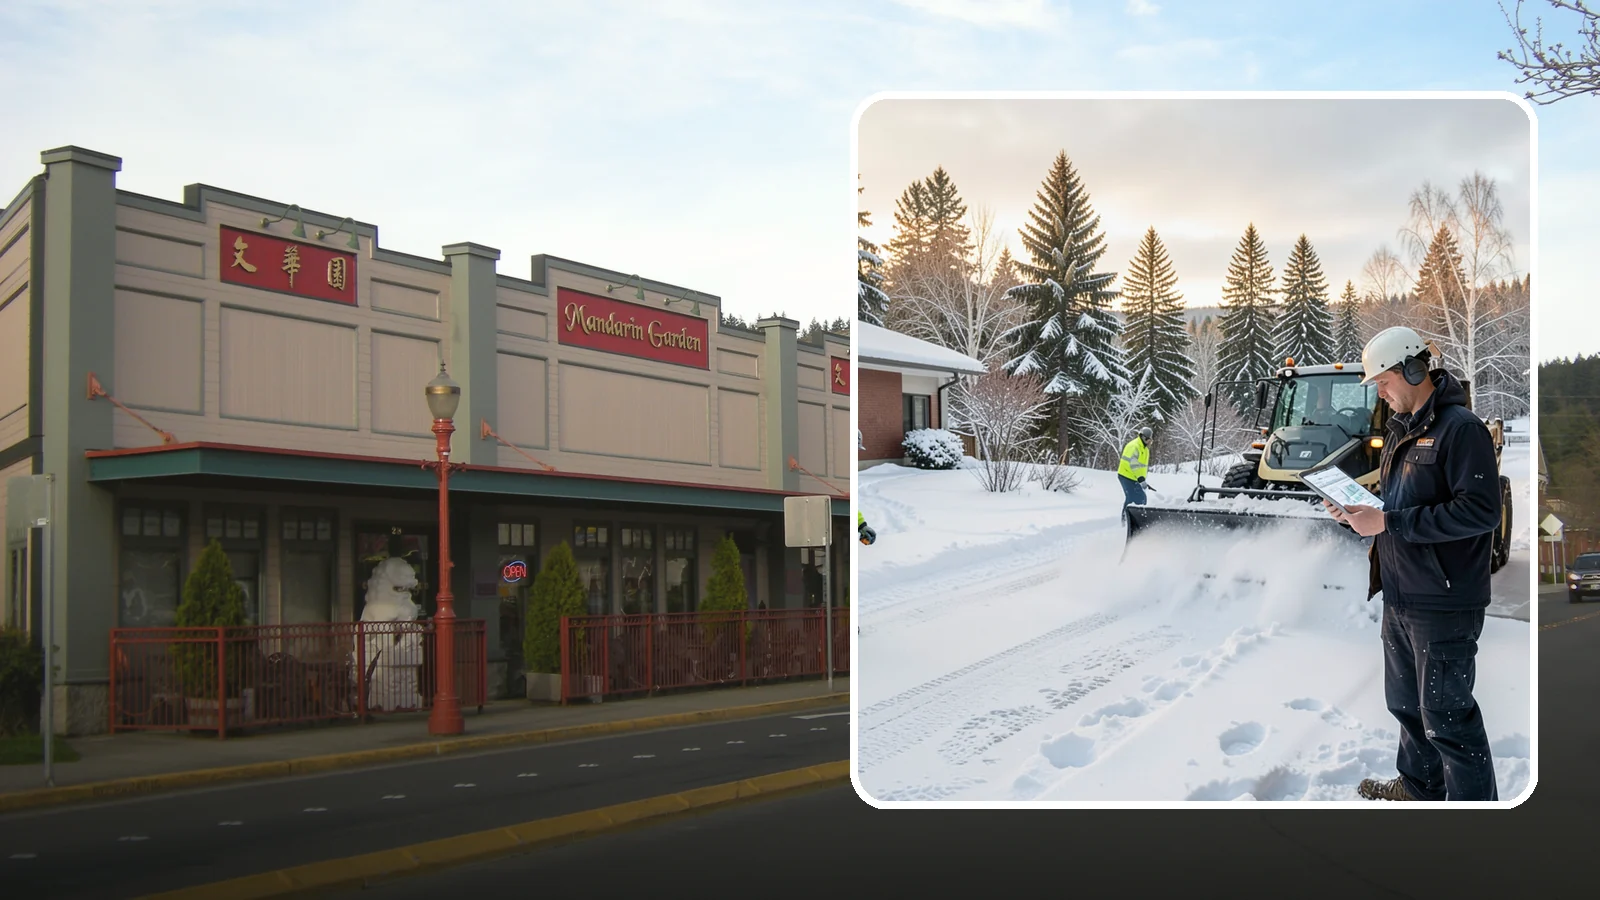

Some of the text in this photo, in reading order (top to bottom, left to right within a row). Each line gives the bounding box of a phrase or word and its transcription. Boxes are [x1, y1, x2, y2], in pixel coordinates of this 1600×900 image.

[564, 302, 702, 352] Mandarin Garden
[503, 565, 527, 578] OPEN
